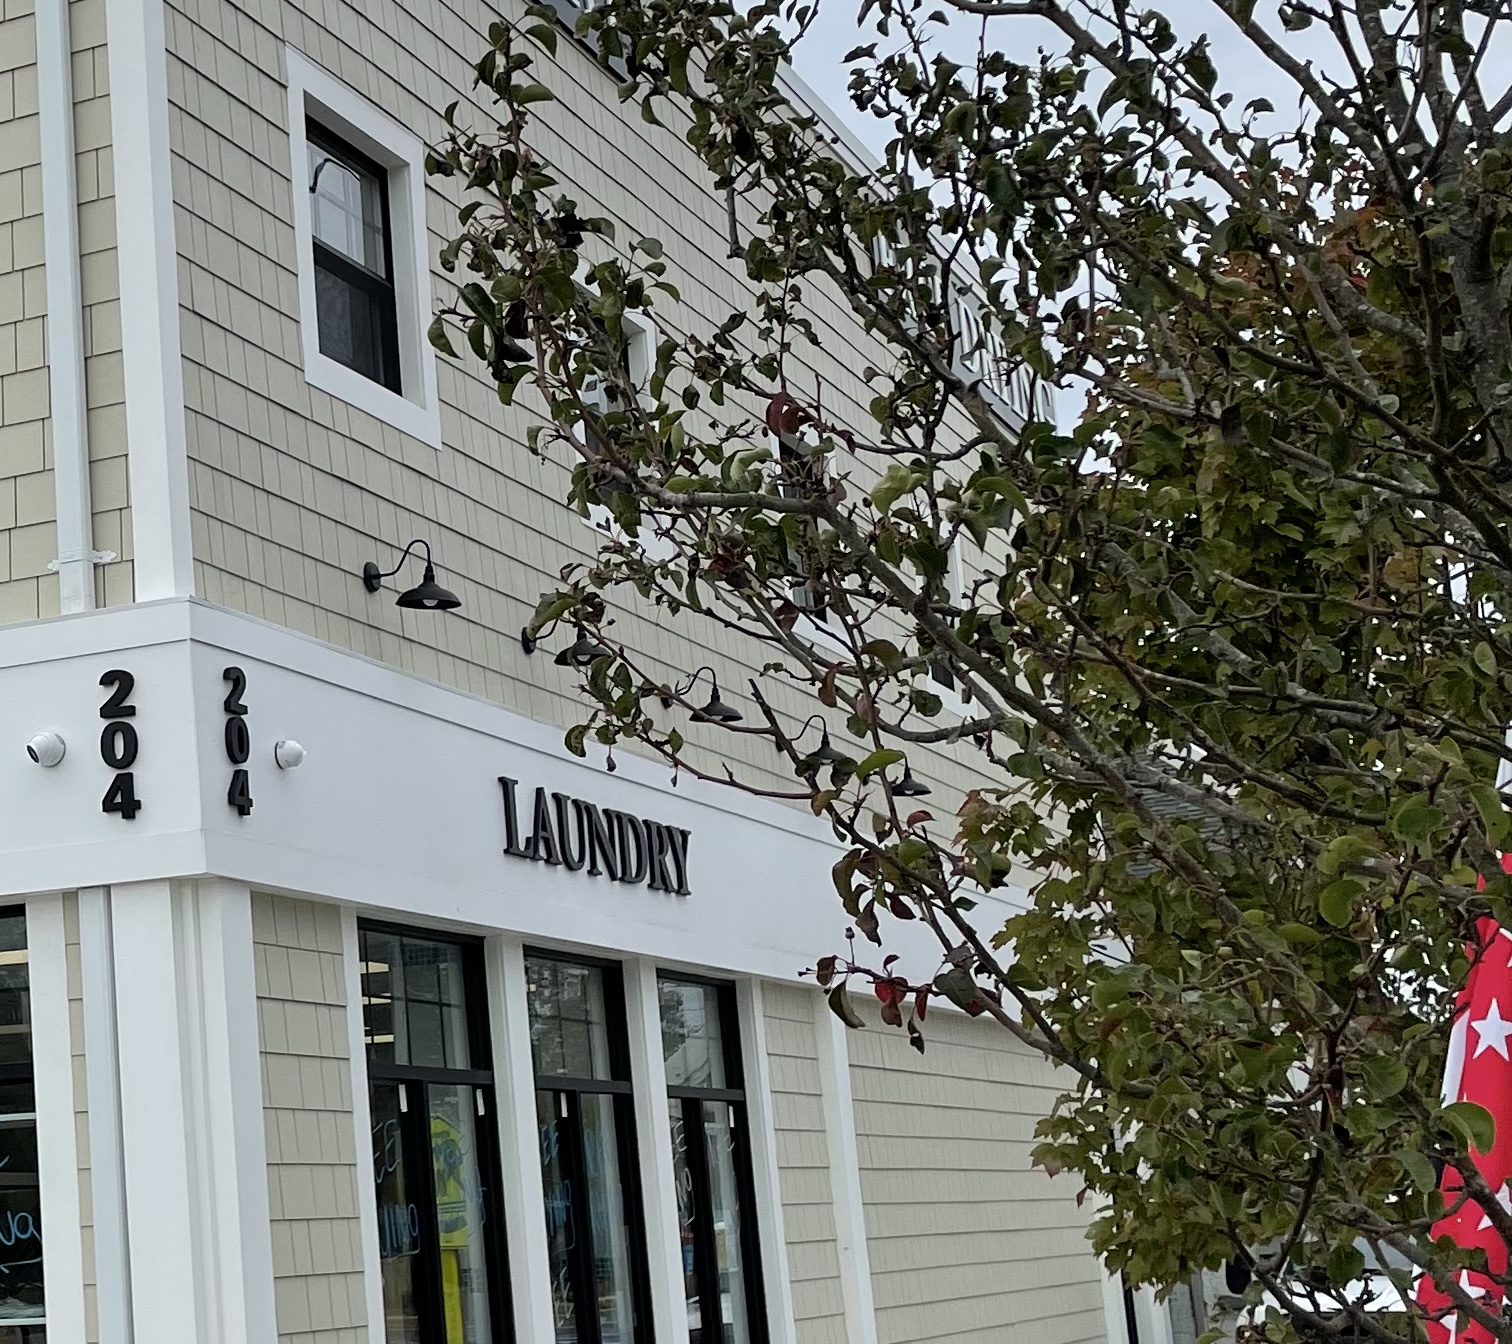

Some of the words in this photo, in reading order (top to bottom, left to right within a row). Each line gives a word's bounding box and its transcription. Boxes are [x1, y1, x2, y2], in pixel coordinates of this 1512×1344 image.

[98, 668, 142, 820] 204
[222, 665, 254, 817] 204
[497, 775, 692, 897] LAUNDRY
